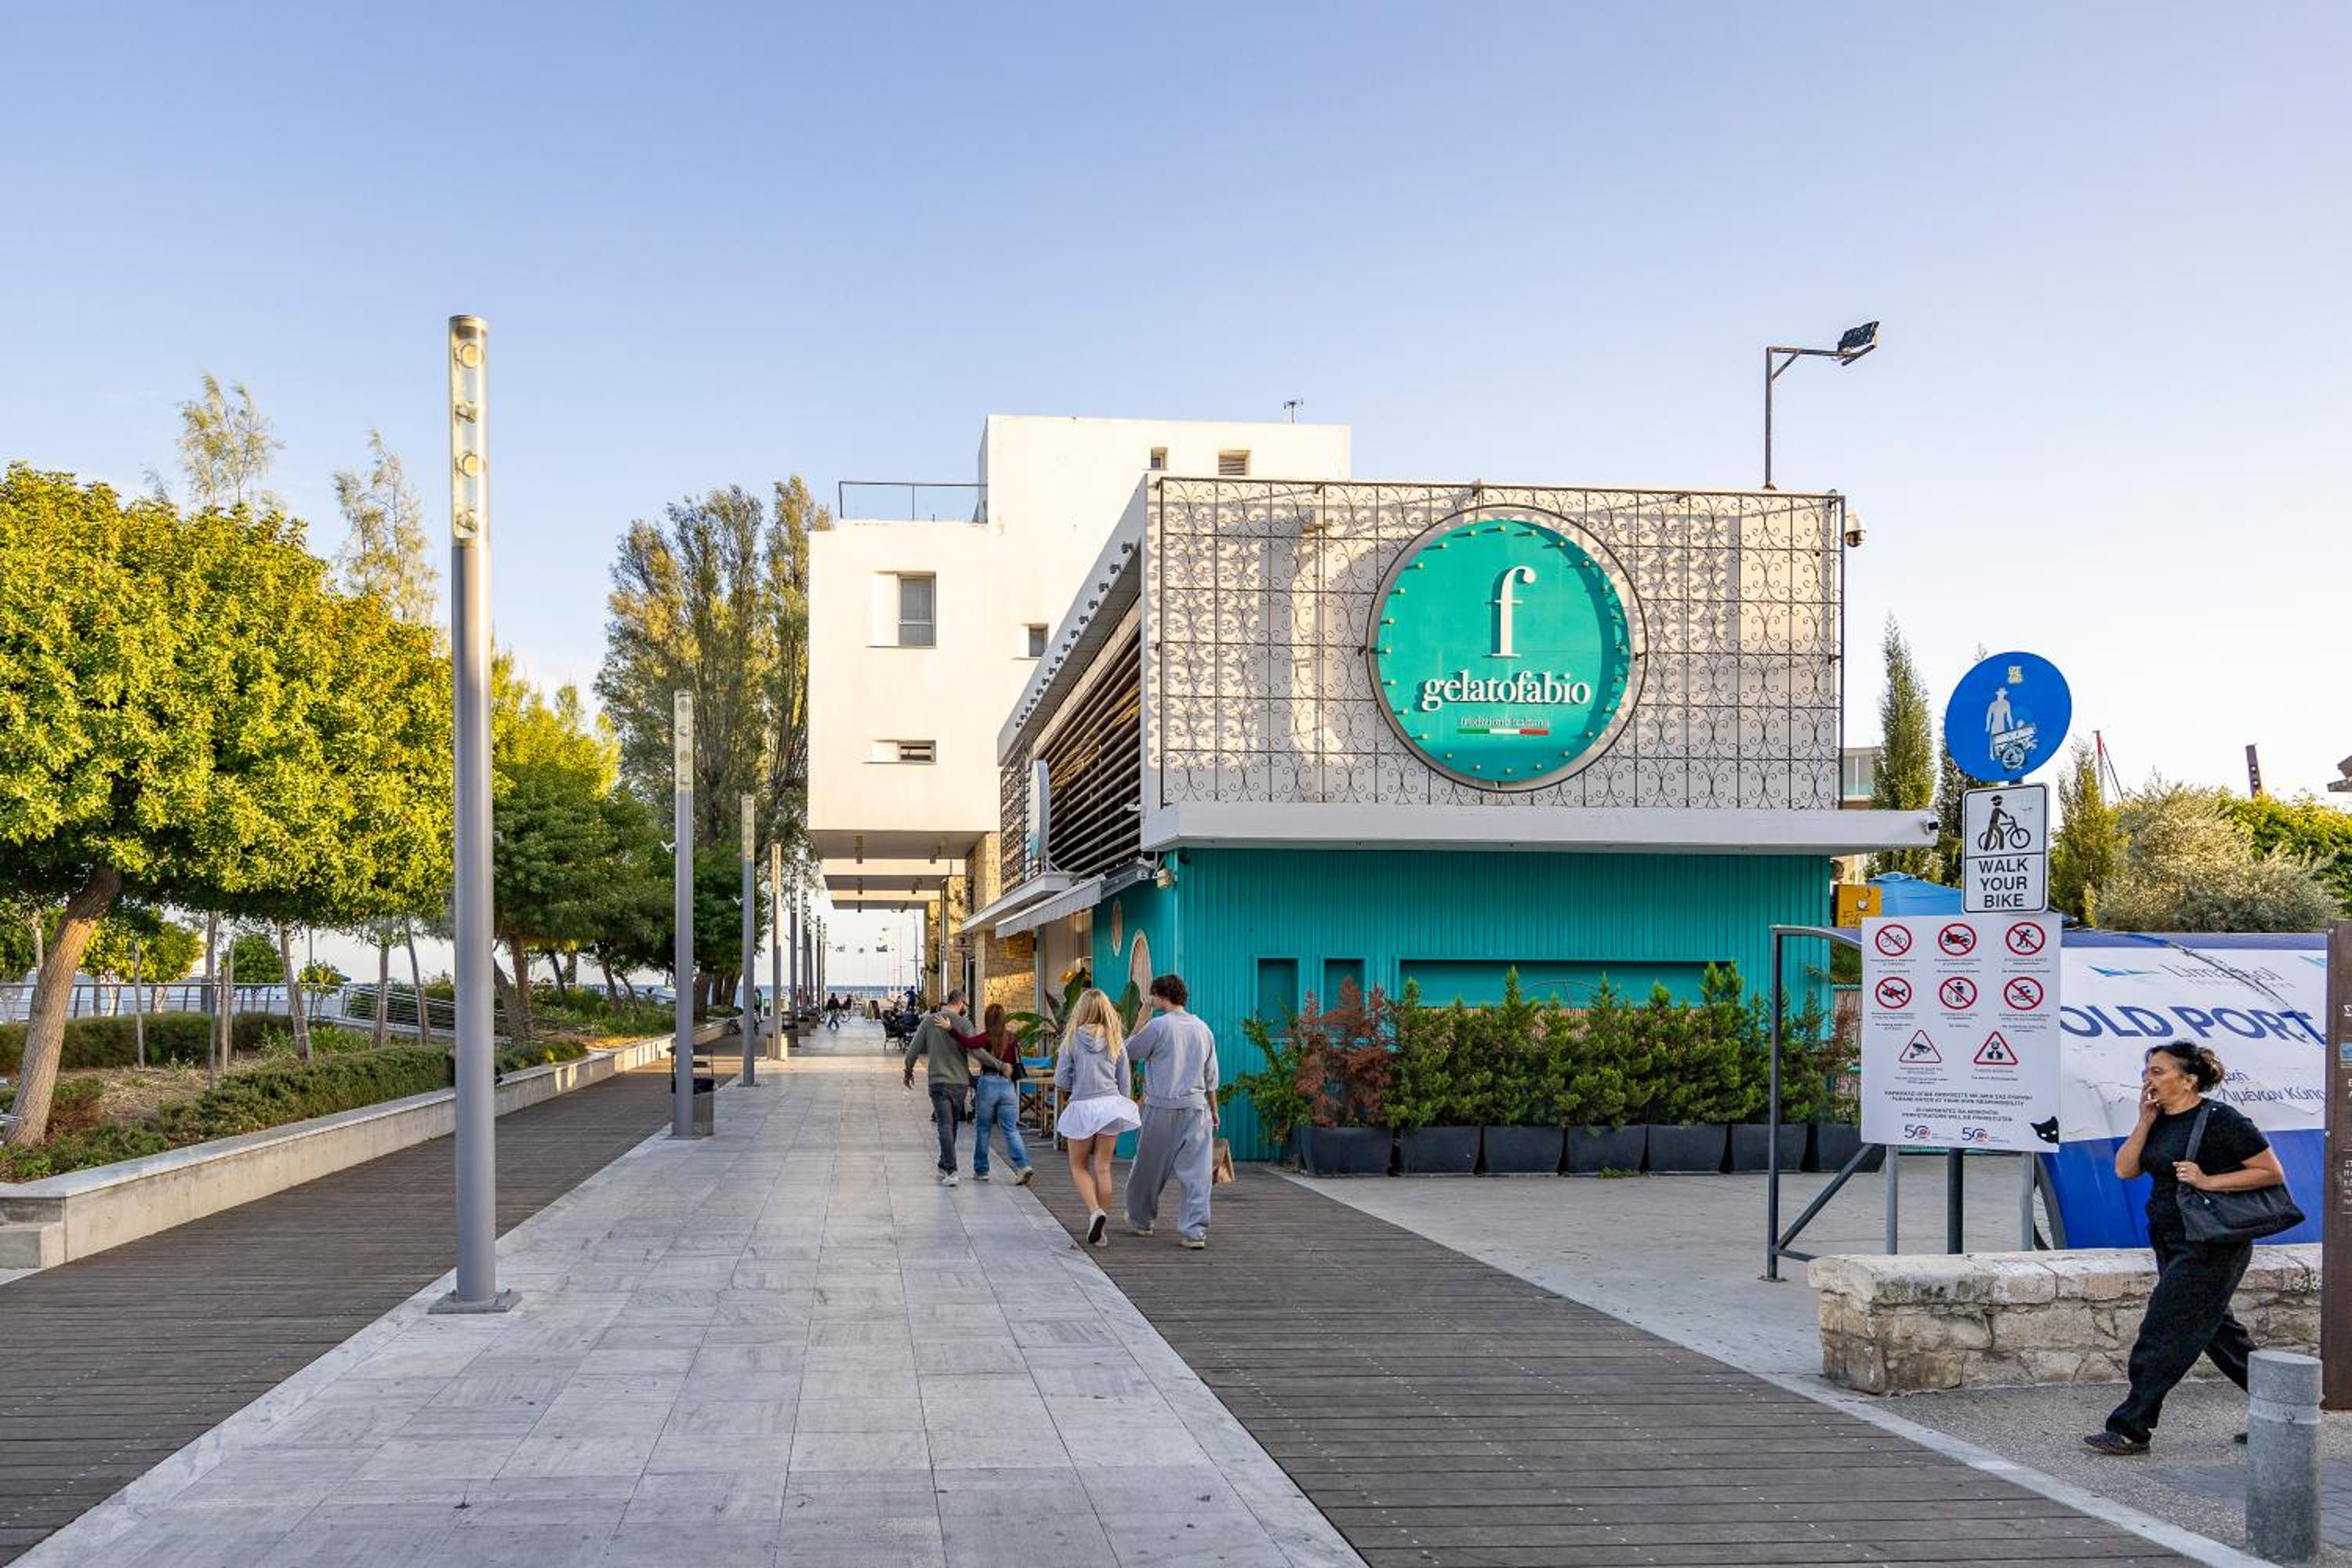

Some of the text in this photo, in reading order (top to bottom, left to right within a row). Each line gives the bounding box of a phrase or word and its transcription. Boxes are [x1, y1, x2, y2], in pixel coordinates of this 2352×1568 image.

[1490, 565, 1537, 657] f
[1421, 669, 1591, 711] gelatofabio
[1978, 857, 2028, 873] WALK
[1980, 876, 2027, 891] YOUR
[1984, 894, 2024, 908] BIKE
[2060, 1005, 2326, 1045] OLD PORT
